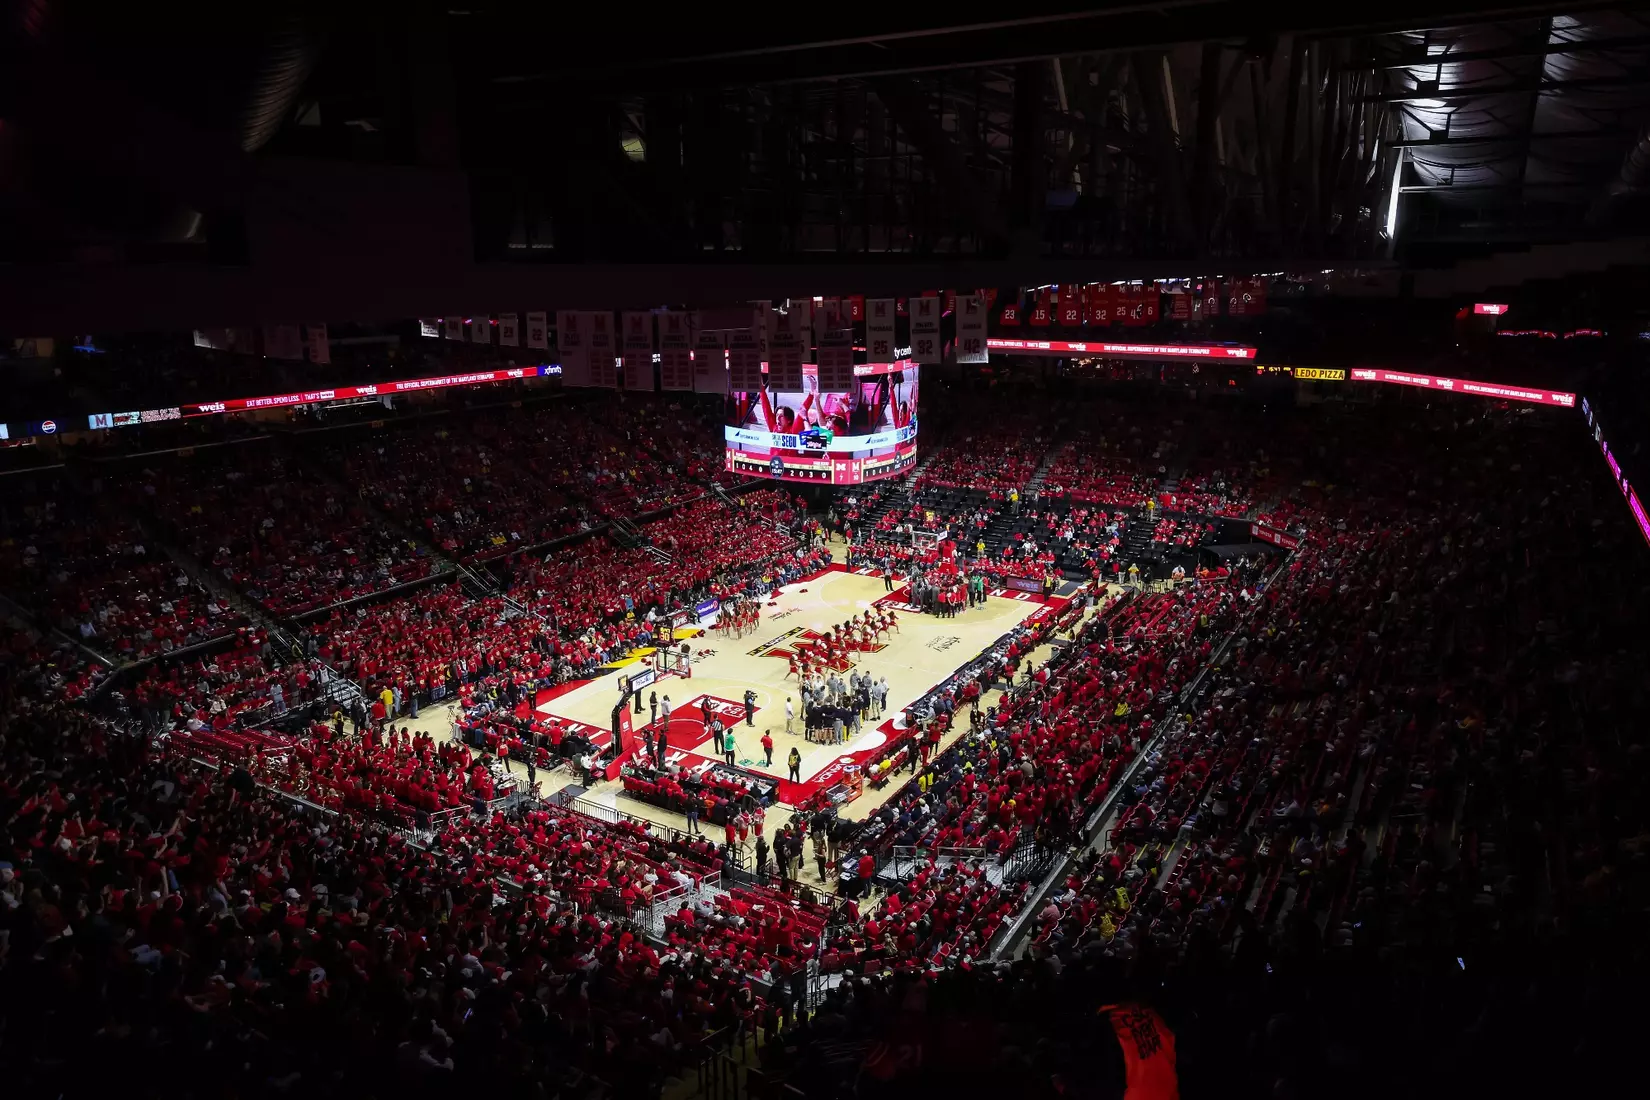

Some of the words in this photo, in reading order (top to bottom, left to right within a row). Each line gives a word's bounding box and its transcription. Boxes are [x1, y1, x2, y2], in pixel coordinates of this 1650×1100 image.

[1005, 309, 1015, 319] 23
[1035, 309, 1045, 320] 15
[1066, 309, 1077, 320] 22
[1095, 309, 1106, 320] 32
[1117, 306, 1126, 316] 25
[874, 340, 888, 355] 25
[964, 339, 980, 354] 42
[1295, 368, 1317, 378] LEDO
[1319, 369, 1344, 380] PIZZA
[421, 379, 446, 387] SUPERMARKET
[458, 375, 477, 383] MARYLAND
[304, 392, 320, 400] THAT'S
[198, 402, 225, 412] weis
[95, 414, 107, 426] M
[781, 435, 797, 448] SECU
[1016, 580, 1039, 589] weis
[660, 633, 670, 641] 30
